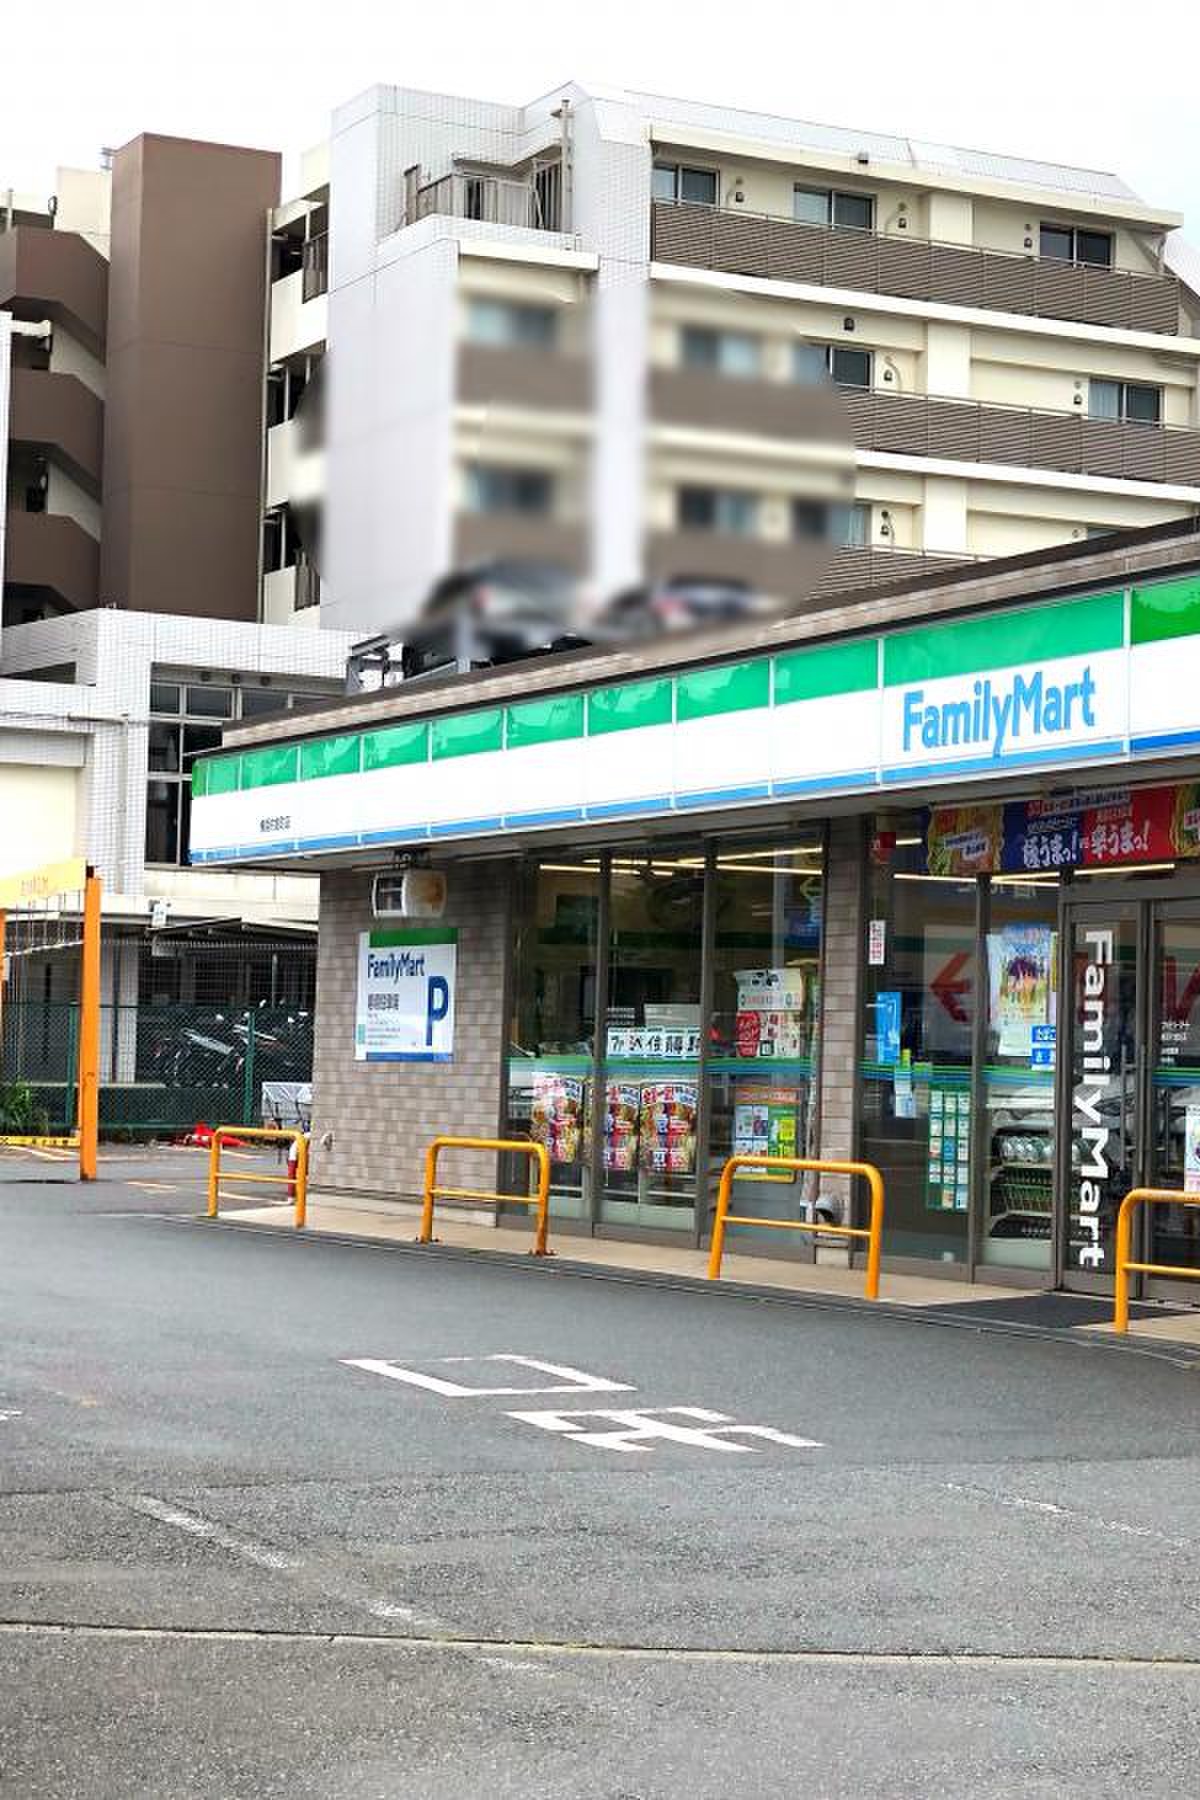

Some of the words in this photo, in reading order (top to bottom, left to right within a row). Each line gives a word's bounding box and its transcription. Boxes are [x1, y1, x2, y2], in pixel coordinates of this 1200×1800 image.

[903, 664, 1096, 763] FamilyMart
[367, 952, 425, 984] FamilyMart
[426, 975, 449, 1046] P
[1074, 930, 1113, 1268] FamilyMart
